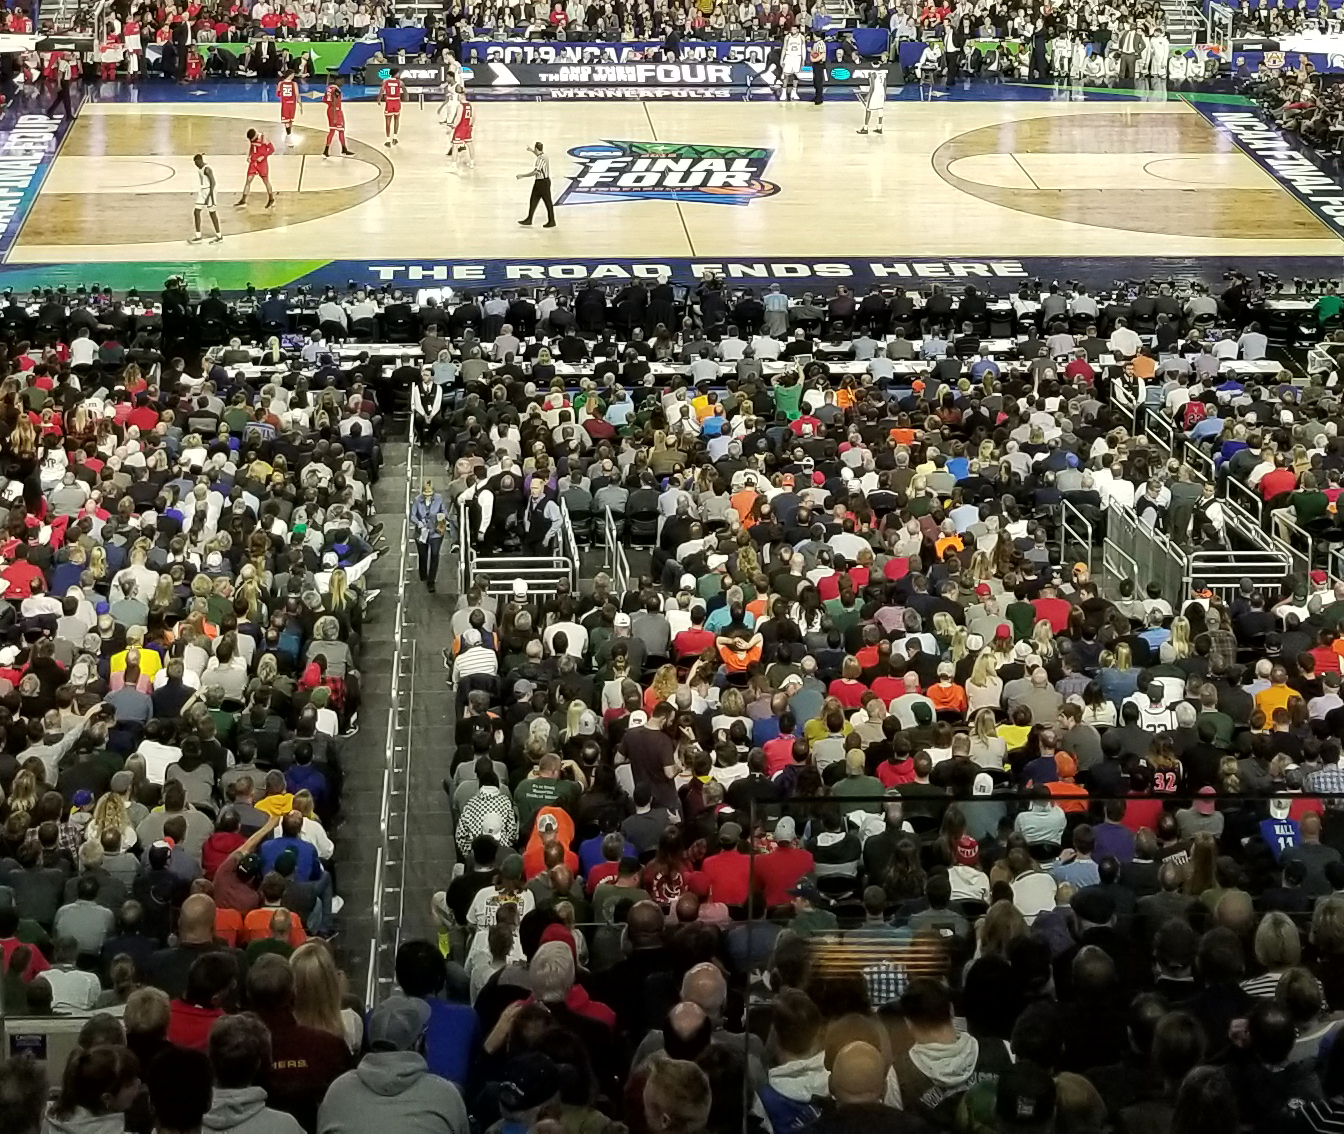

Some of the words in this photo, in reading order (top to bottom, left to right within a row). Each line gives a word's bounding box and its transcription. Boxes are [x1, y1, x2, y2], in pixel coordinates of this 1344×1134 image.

[399, 68, 440, 80] AT&T
[637, 65, 733, 83] FOUR
[283, 86, 293, 97] 25
[550, 90, 732, 98] MINNEAPOLIS
[1211, 112, 1291, 150] NCAA
[1256, 150, 1343, 195] FINAL
[573, 157, 758, 172] FINAL
[565, 172, 752, 187] FOUR
[368, 262, 487, 280] THE
[504, 262, 660, 280] ROAD
[692, 262, 859, 280] ENDS
[868, 262, 1034, 280] HERE
